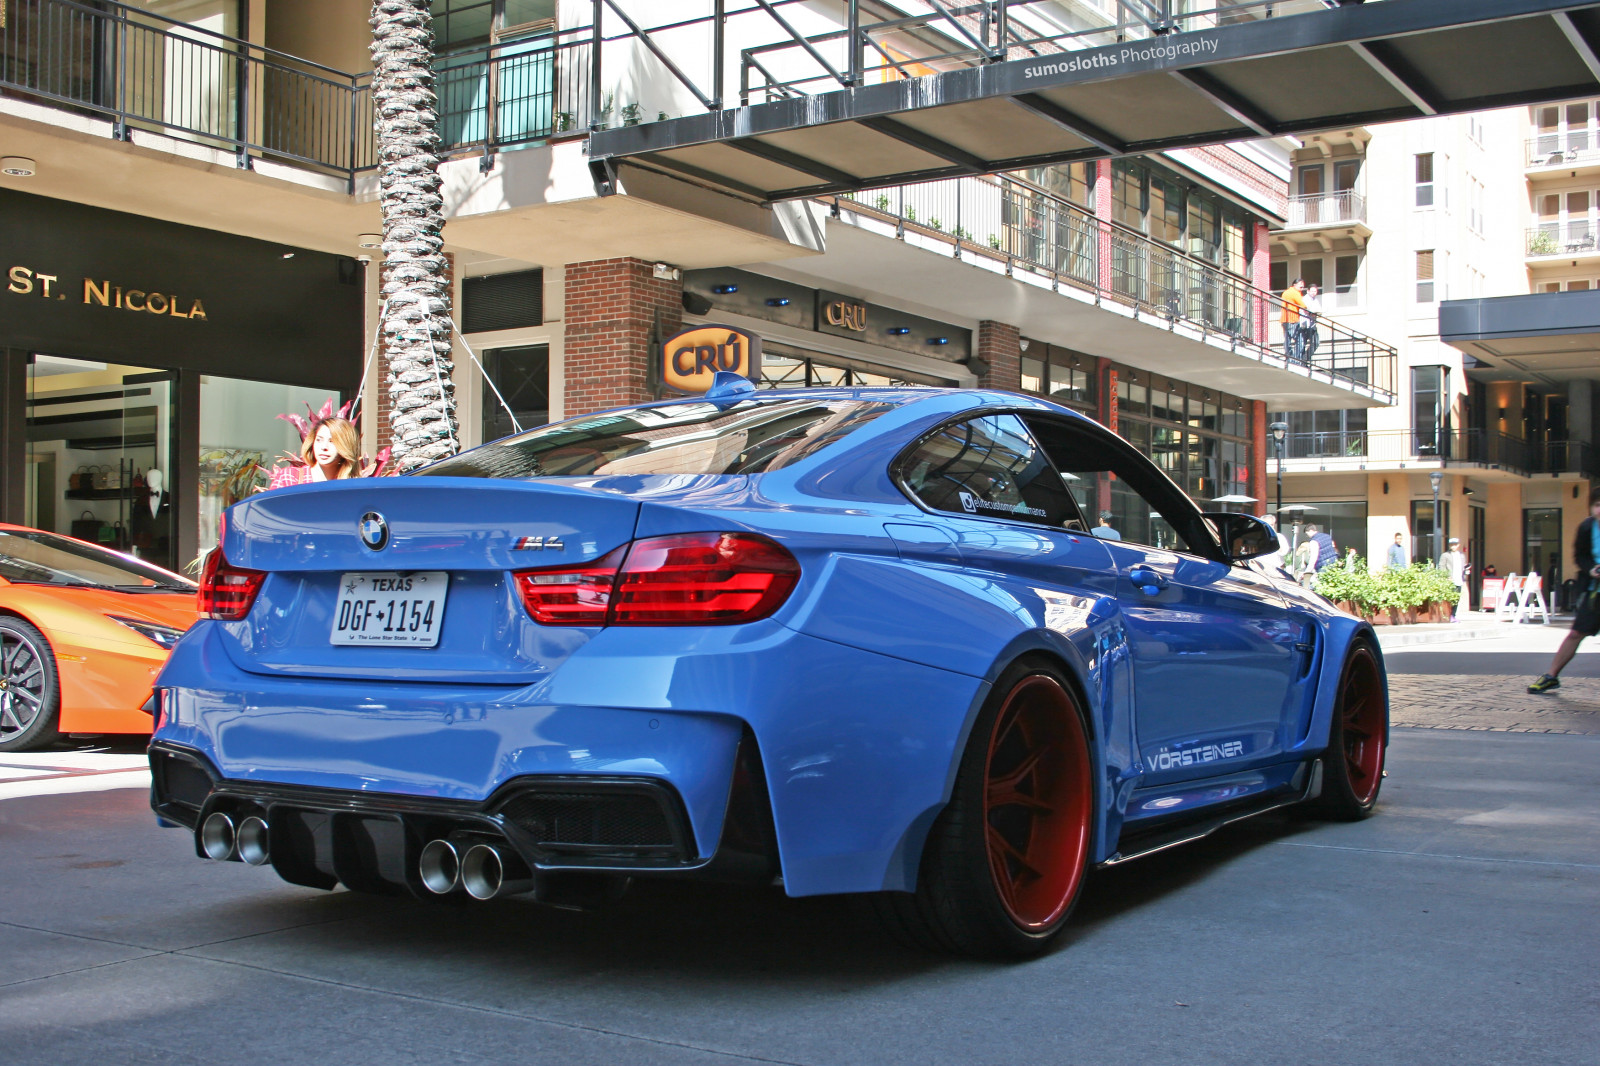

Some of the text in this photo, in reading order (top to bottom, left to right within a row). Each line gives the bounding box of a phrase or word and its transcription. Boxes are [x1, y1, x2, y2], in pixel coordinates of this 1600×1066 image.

[8, 265, 209, 322] ST. NICOLA
[672, 333, 741, 377] CRÚ
[515, 536, 564, 551] M4
[372, 578, 413, 592] TEXAS
[1147, 741, 1244, 772] VÖRSTEINER
